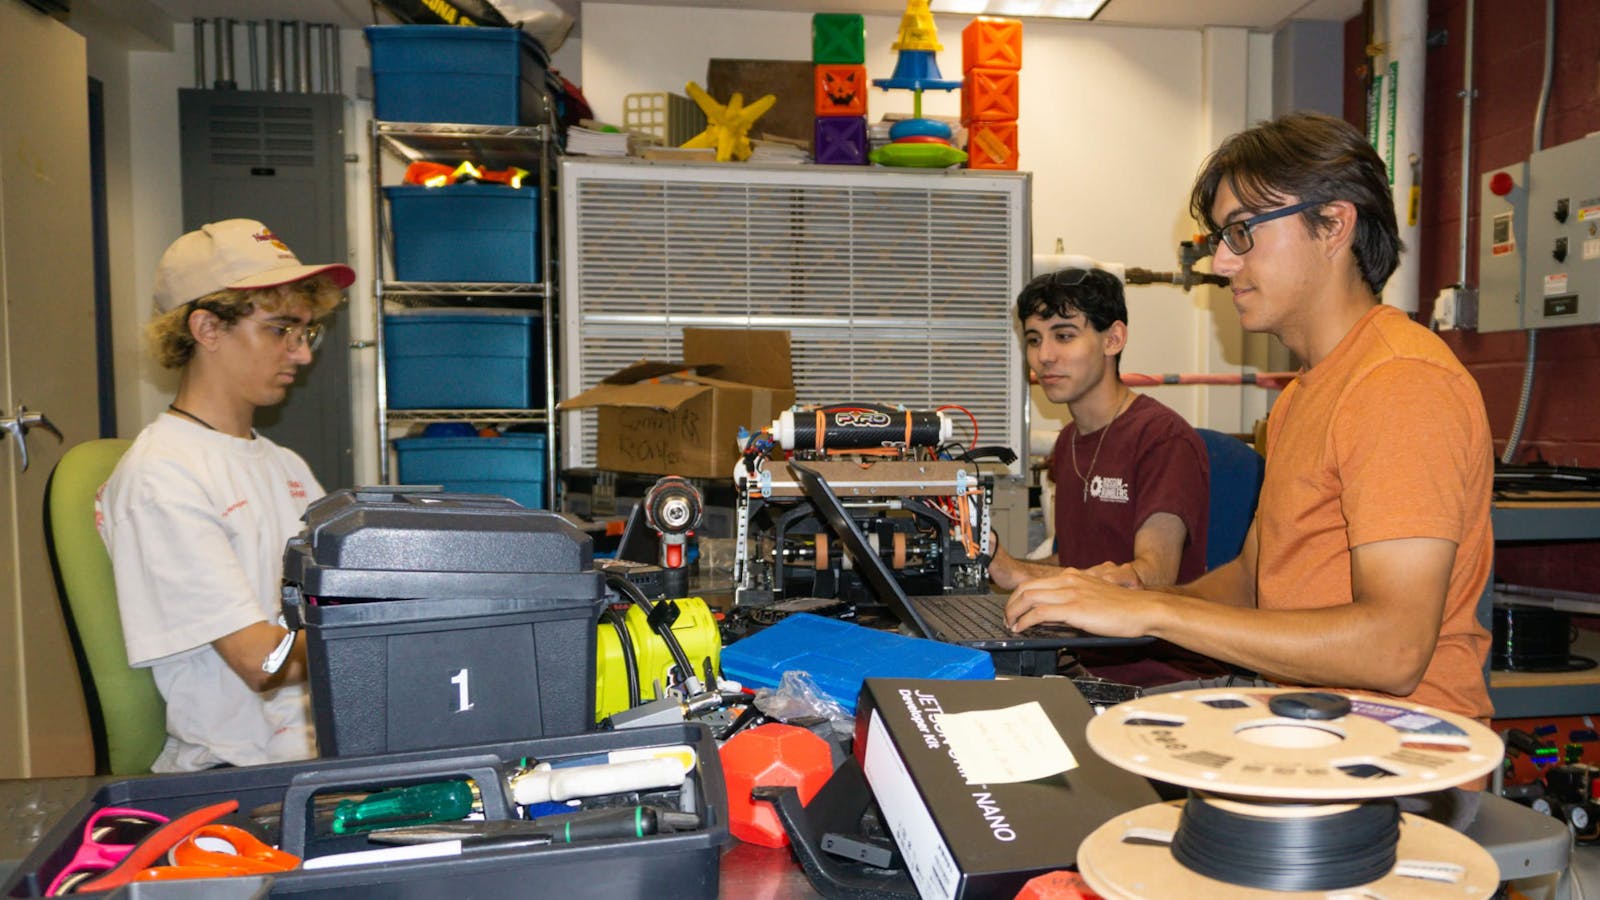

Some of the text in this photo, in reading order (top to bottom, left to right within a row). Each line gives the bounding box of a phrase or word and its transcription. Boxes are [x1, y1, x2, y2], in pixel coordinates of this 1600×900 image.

[451, 668, 475, 713] 1
[899, 689, 940, 749] Developer Kit
[972, 792, 1016, 842] NANO
